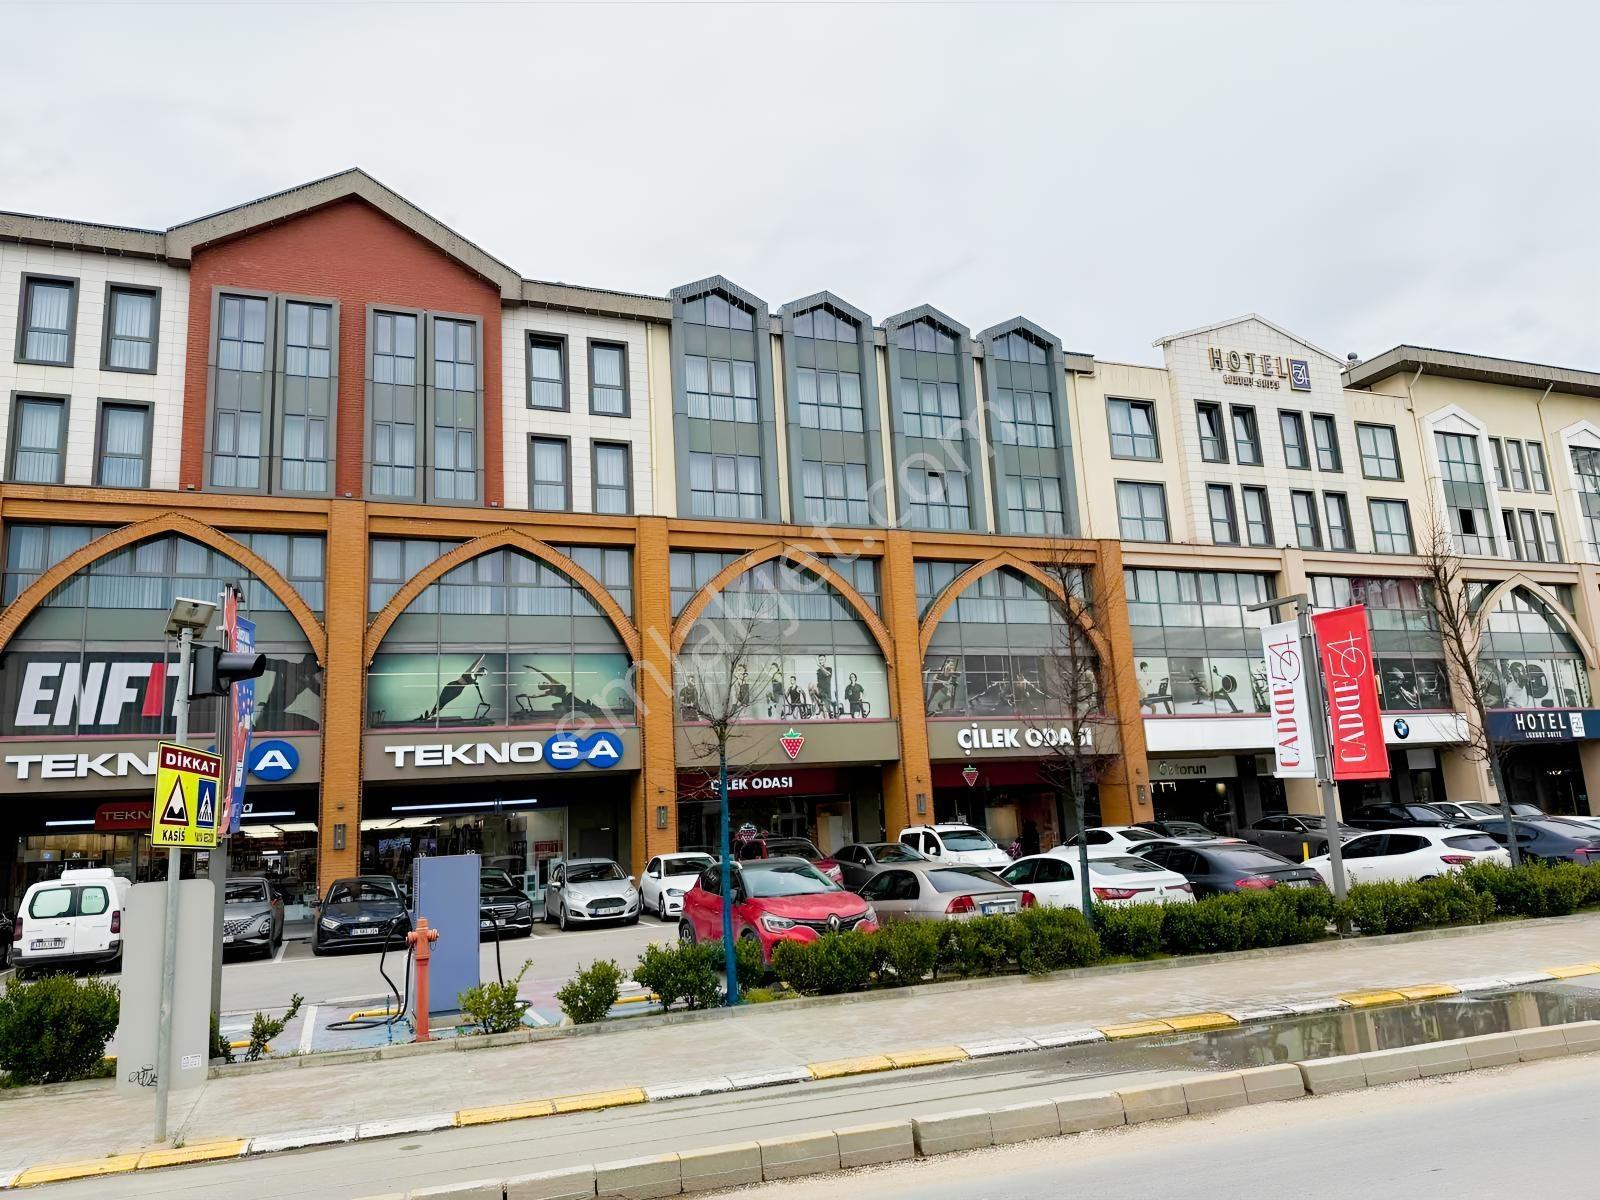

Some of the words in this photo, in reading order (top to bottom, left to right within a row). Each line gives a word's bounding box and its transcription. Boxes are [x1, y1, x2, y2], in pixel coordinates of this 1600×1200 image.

[1208, 348, 1288, 379] HOTEL
[1515, 712, 1567, 730] HOTEL
[957, 722, 1021, 755] ÇİLEK
[165, 752, 217, 774] DİKKAT
[385, 740, 619, 768] TEKNOSA
[751, 777, 793, 789] ODASI
[162, 828, 186, 842] KASİS
